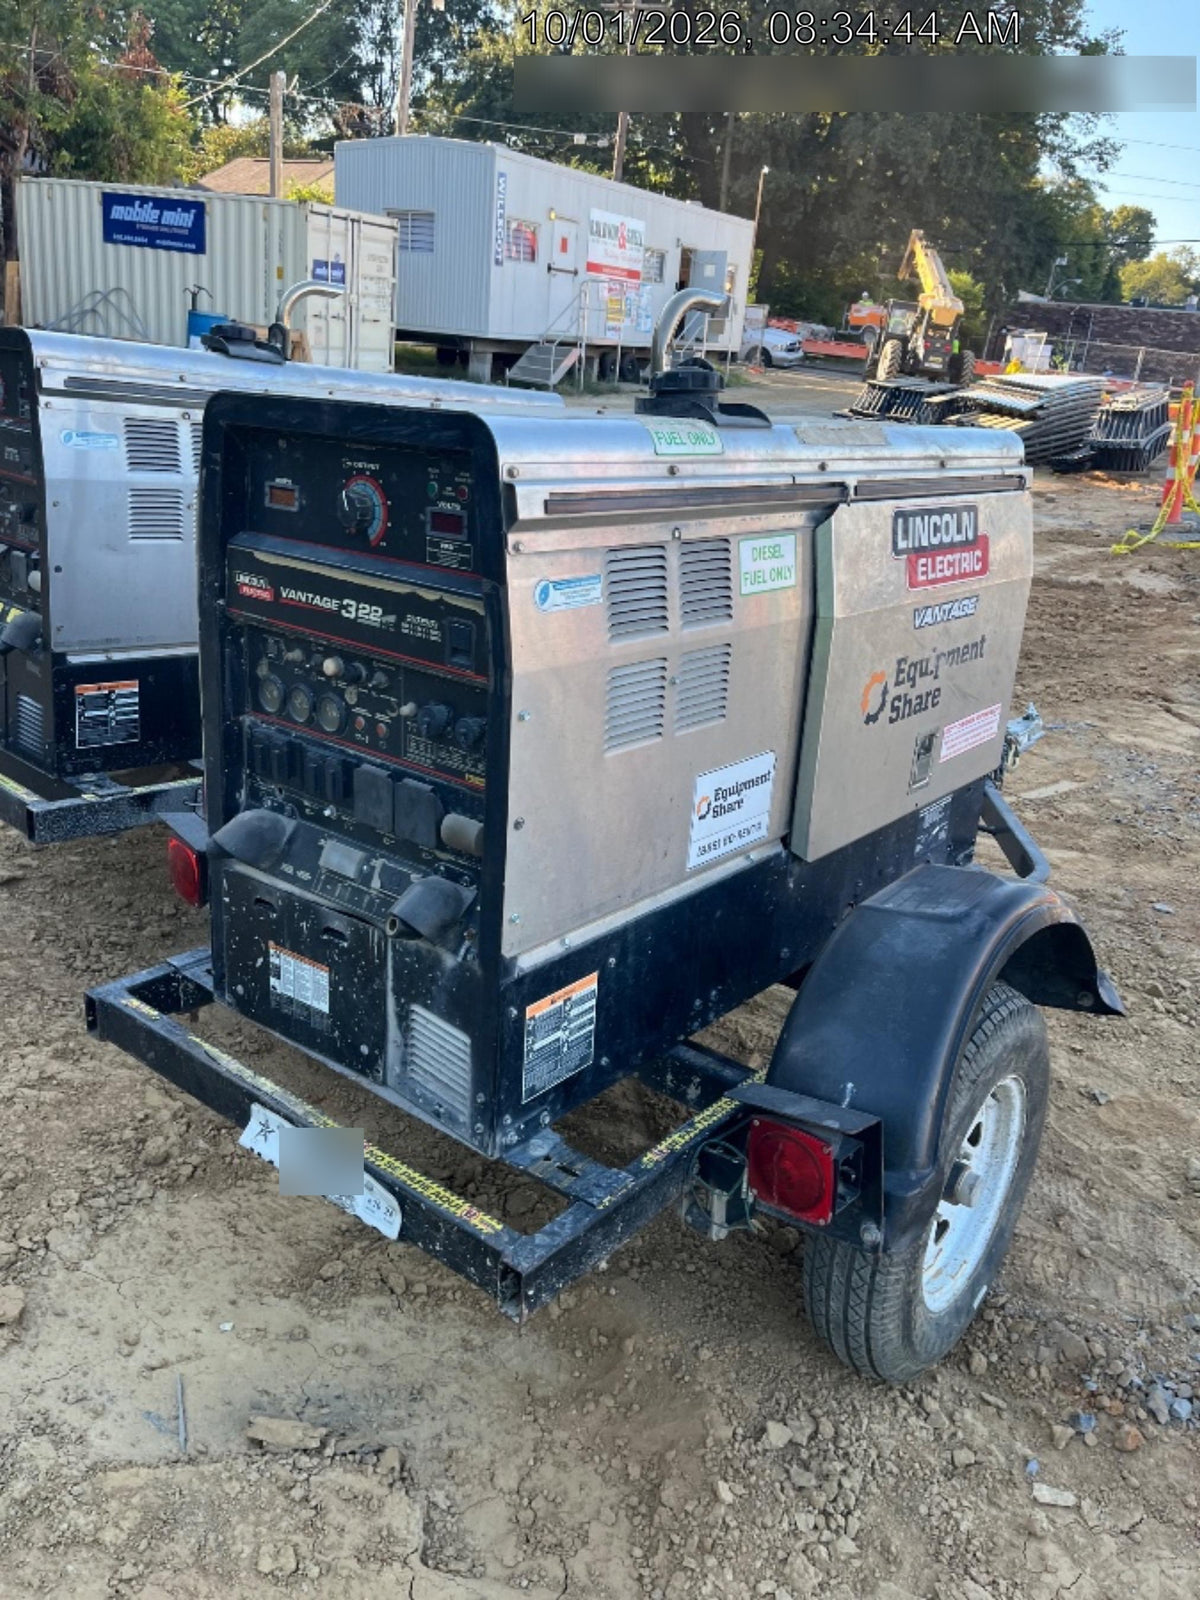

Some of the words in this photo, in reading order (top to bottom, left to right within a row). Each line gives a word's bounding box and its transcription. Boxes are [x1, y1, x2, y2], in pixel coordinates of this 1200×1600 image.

[110, 200, 160, 224] mobile
[161, 207, 196, 228] mini
[654, 431, 686, 445] FUEL
[687, 431, 716, 445] ONLY
[897, 511, 975, 550] LINCOLN
[751, 543, 785, 562] DIESEL
[917, 550, 983, 582] ELECTRIC
[743, 569, 768, 587] FUEL
[769, 564, 794, 582] ONLY
[280, 586, 340, 611] VANTAGE
[341, 598, 383, 624] 322
[913, 595, 980, 630] VANTAGE
[888, 687, 942, 725] Share
[714, 770, 772, 803] Equipment
[712, 797, 745, 820] Share
